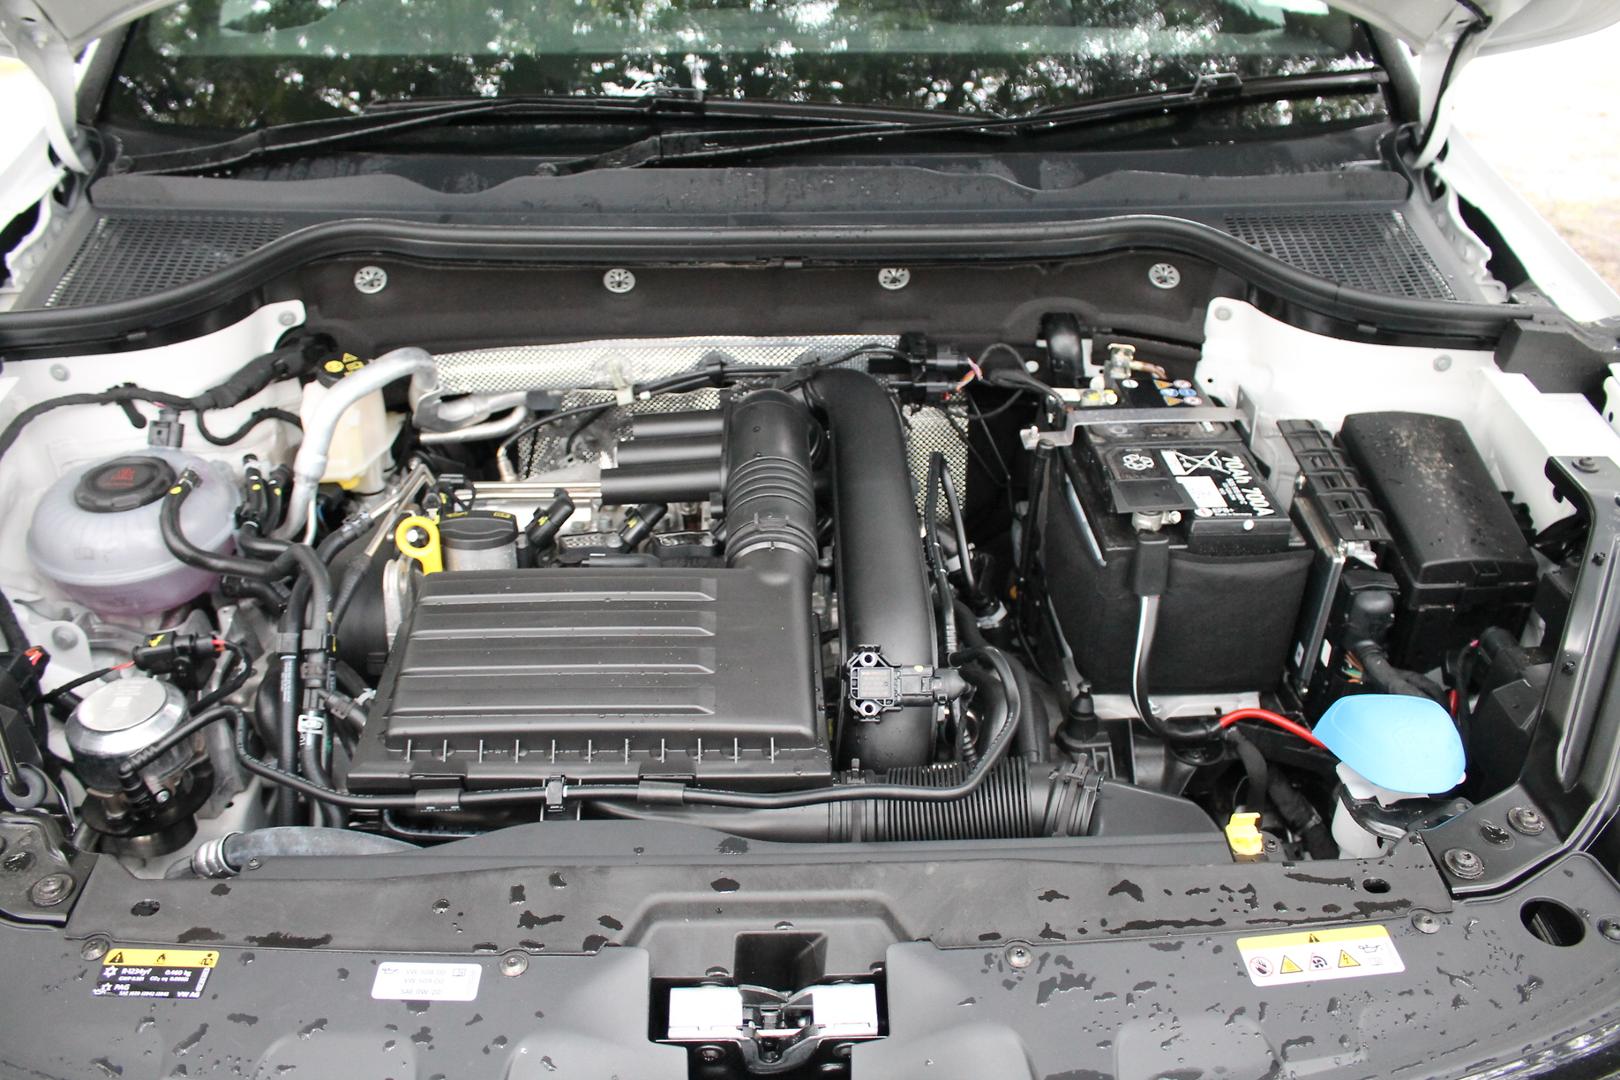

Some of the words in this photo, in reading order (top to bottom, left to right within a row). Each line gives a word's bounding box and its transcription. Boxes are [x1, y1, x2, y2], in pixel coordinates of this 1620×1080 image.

[1221, 456, 1252, 484] 70Ah
[1241, 487, 1275, 517] 700A
[114, 983, 130, 991] PAG
